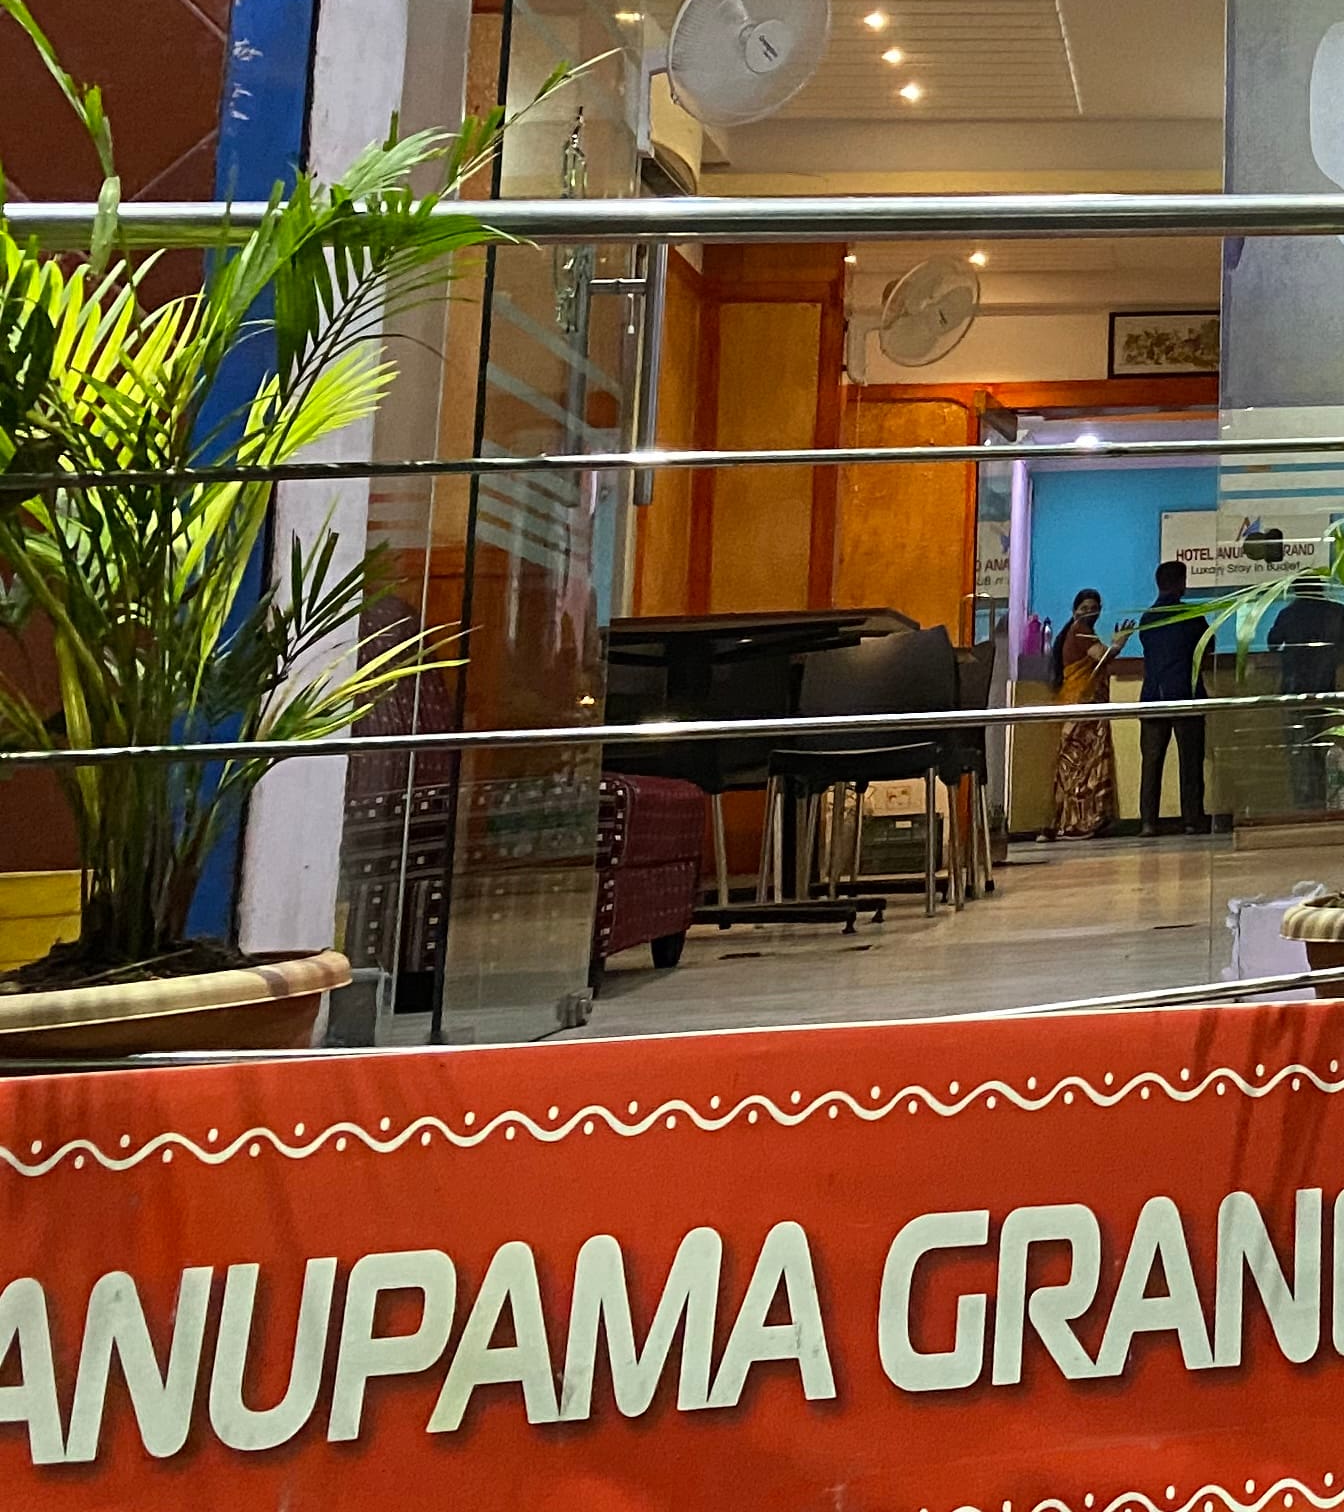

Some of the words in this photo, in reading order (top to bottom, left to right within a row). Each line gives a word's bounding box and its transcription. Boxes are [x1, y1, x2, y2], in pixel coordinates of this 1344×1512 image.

[1176, 547, 1214, 561] HOTEL
[1281, 543, 1315, 557] RAND
[0, 1220, 837, 1465] ANUPAMA
